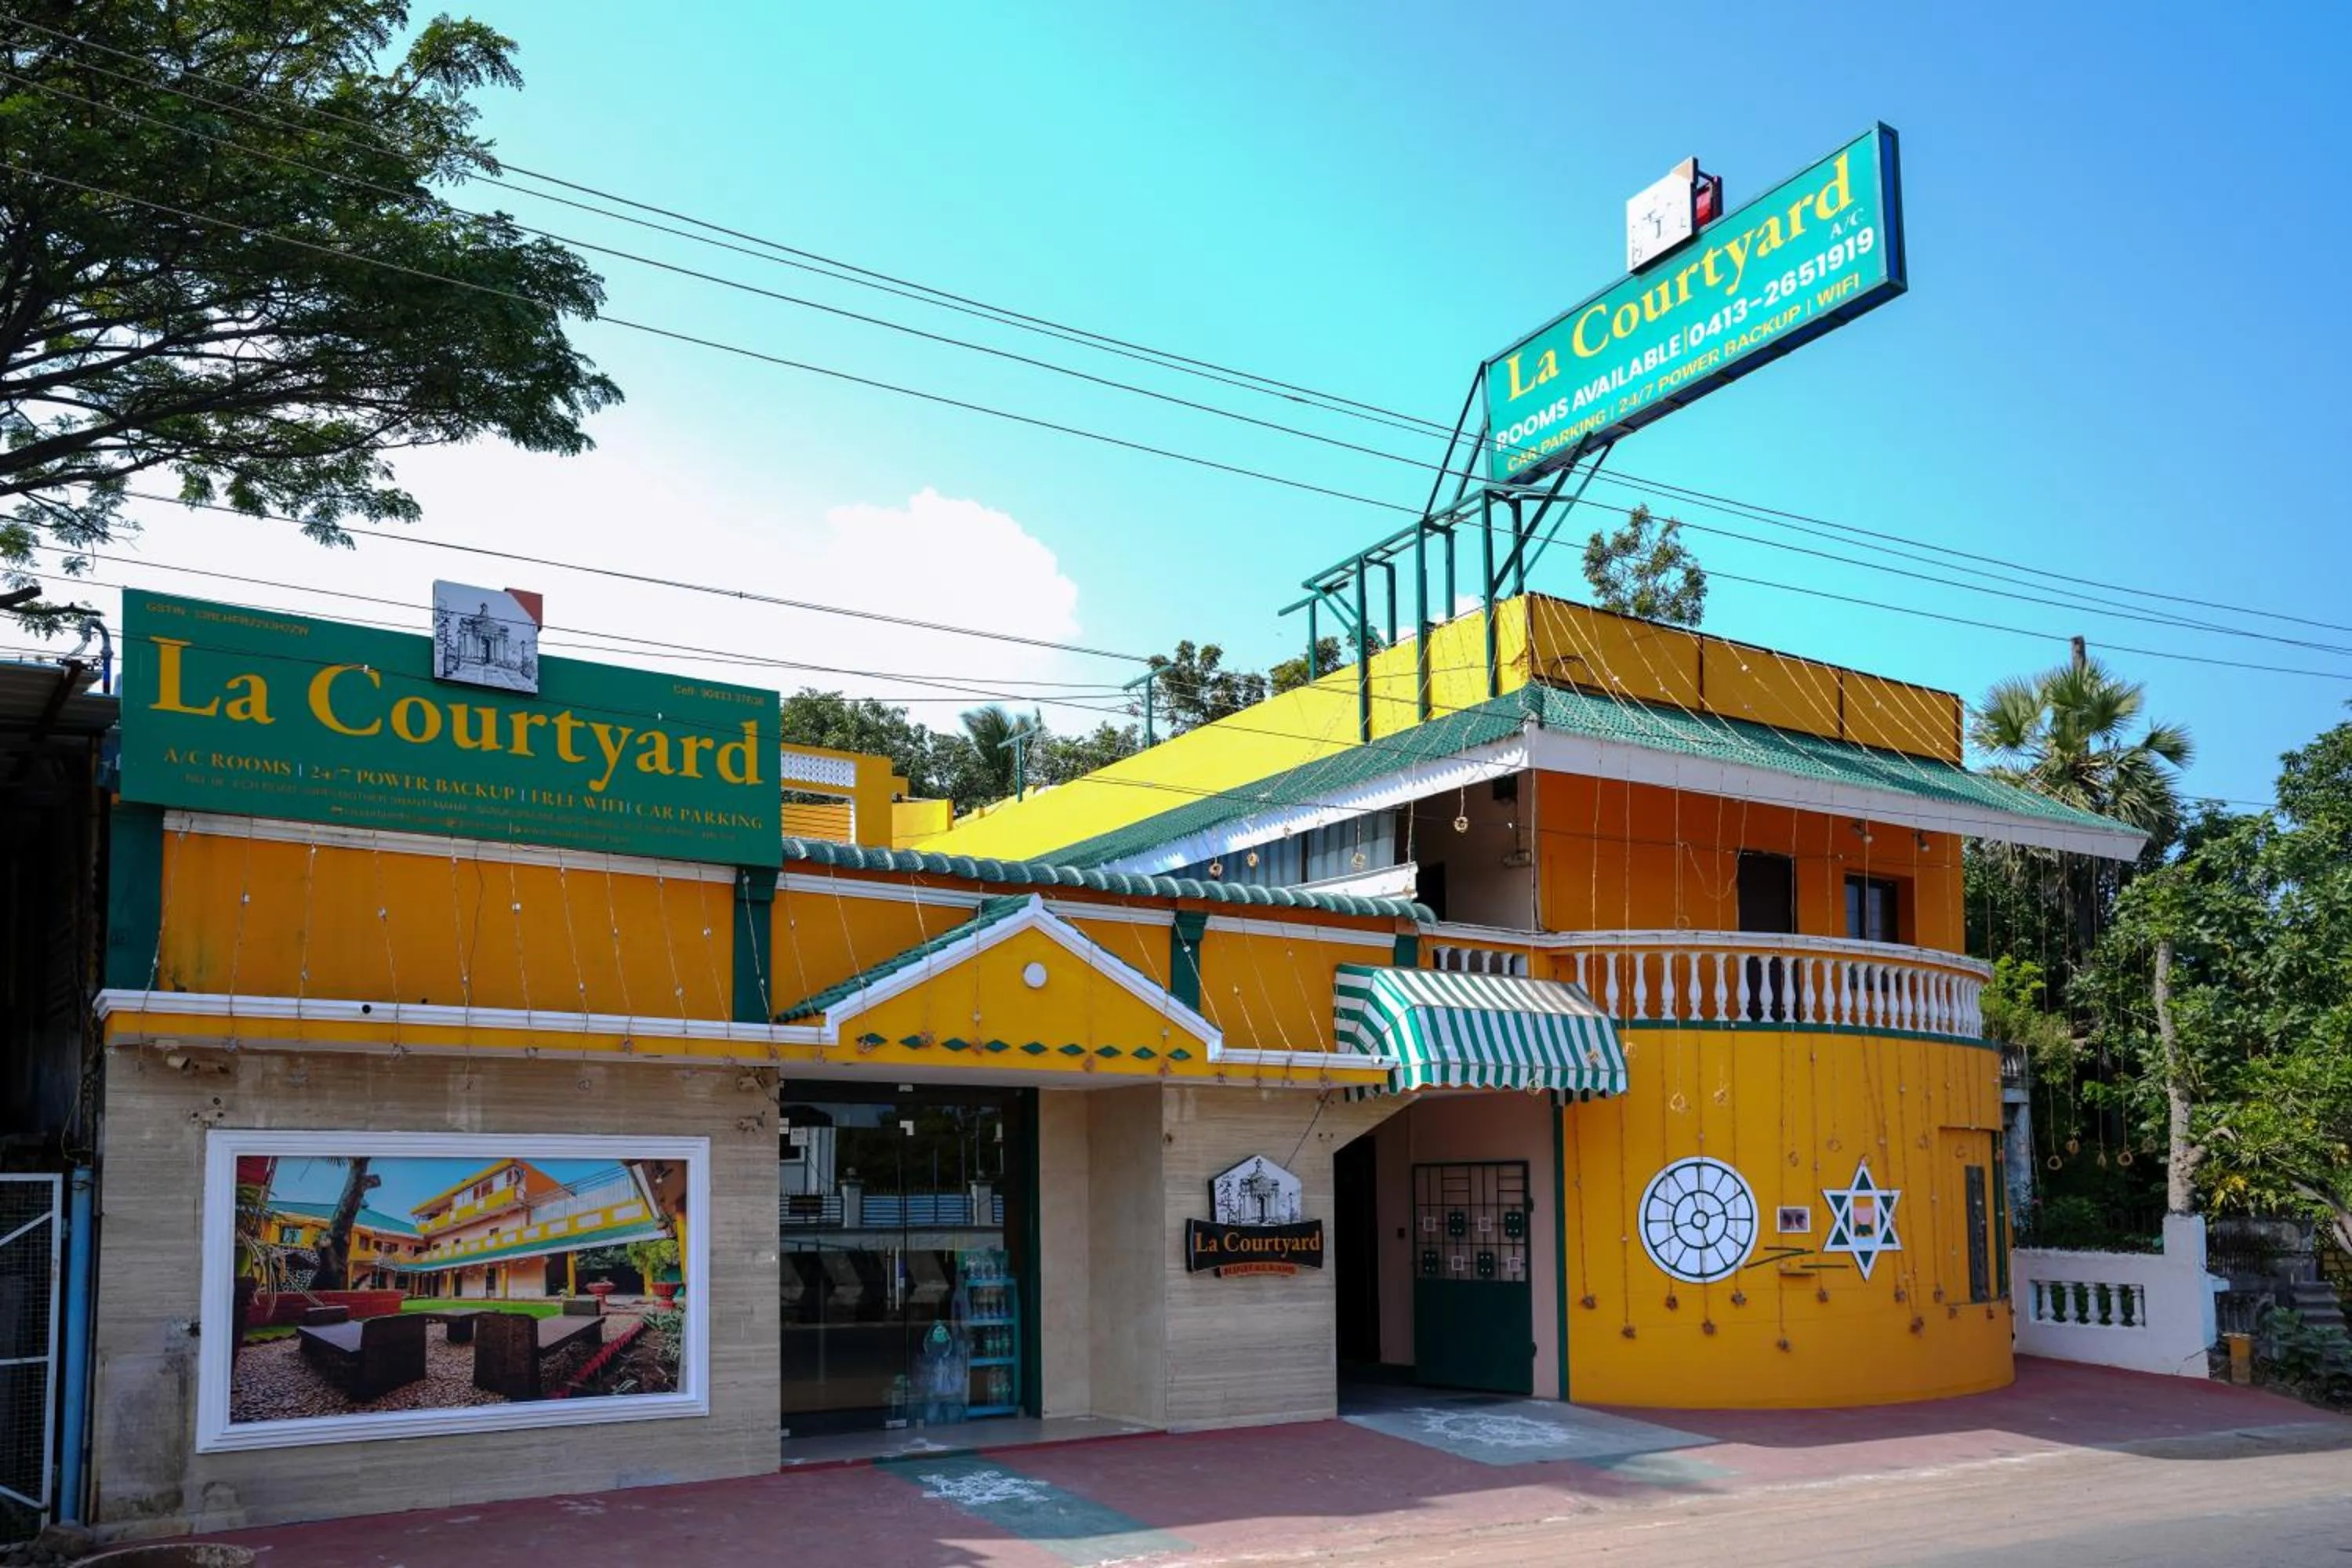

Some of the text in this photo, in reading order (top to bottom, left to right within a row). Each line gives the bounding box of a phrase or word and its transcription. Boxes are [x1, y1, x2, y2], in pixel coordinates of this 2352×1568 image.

[1506, 153, 1854, 401] La Courtyard
[1830, 206, 1865, 240] A/C
[1496, 227, 1874, 452] ROOMS AVAILABLE 0413-2651919
[1540, 408, 1606, 454] PARKING
[1657, 348, 1720, 393] POWER
[1724, 304, 1802, 357] BACKUP
[1817, 272, 1860, 307] WIFI
[149, 635, 764, 793] La Courtyard
[164, 746, 202, 765] A/C
[212, 753, 292, 777] ROOMS
[357, 769, 430, 793] POWER
[436, 778, 516, 802] BACKUP
[634, 801, 674, 820] CAR
[679, 808, 762, 829] PARKING
[1195, 1231, 1320, 1258] La Courtyard
